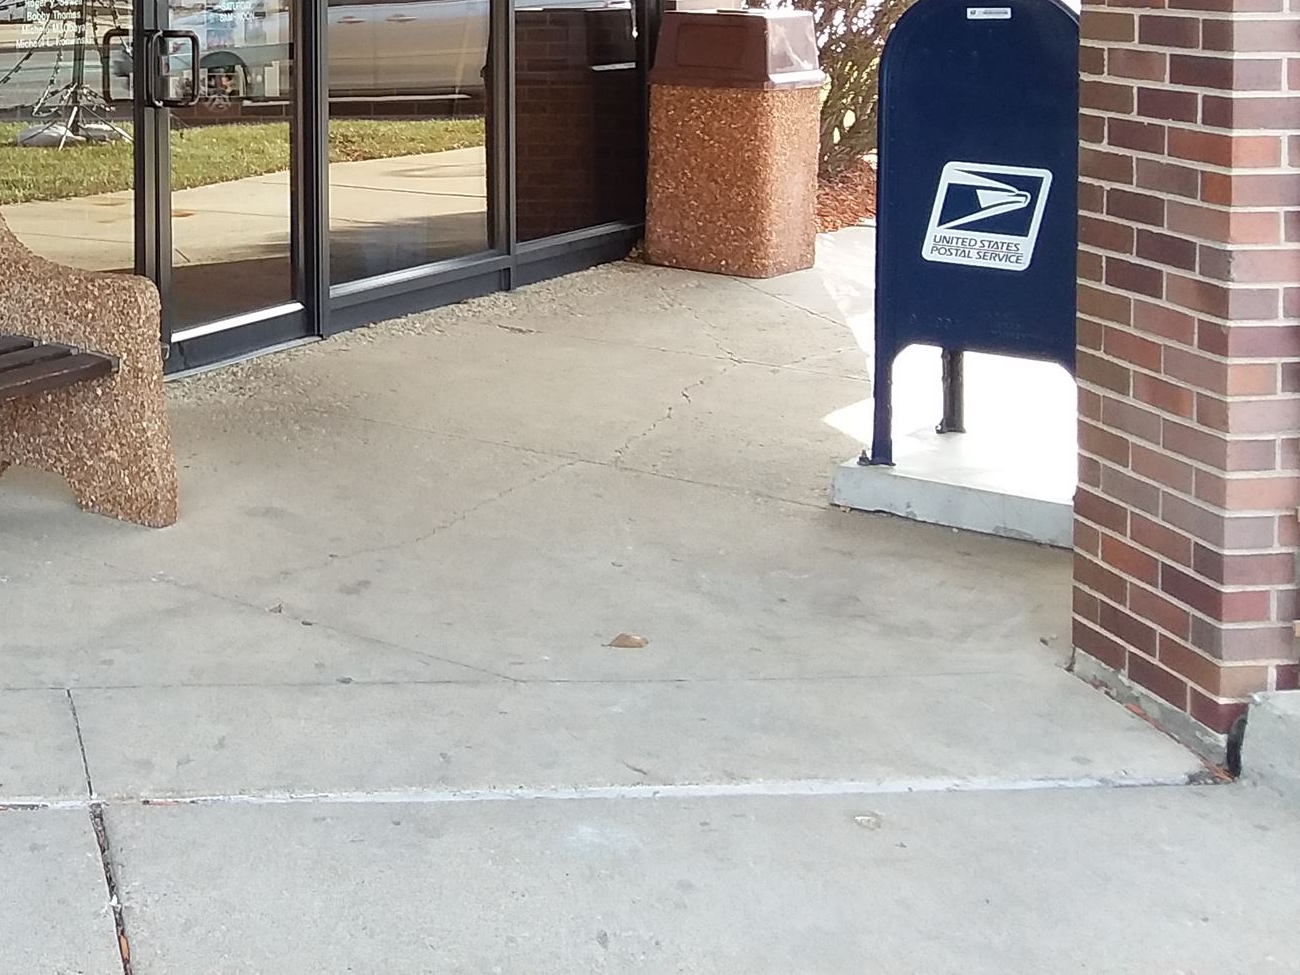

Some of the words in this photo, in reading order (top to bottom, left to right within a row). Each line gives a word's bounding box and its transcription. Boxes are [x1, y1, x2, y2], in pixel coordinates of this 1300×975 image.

[27, 11, 50, 21] Bobby
[52, 9, 81, 19] Thomas
[933, 234, 977, 246] UNITED
[979, 239, 1020, 251] STATES
[930, 245, 973, 258] POSTAL
[975, 251, 1023, 264] SERVICE
